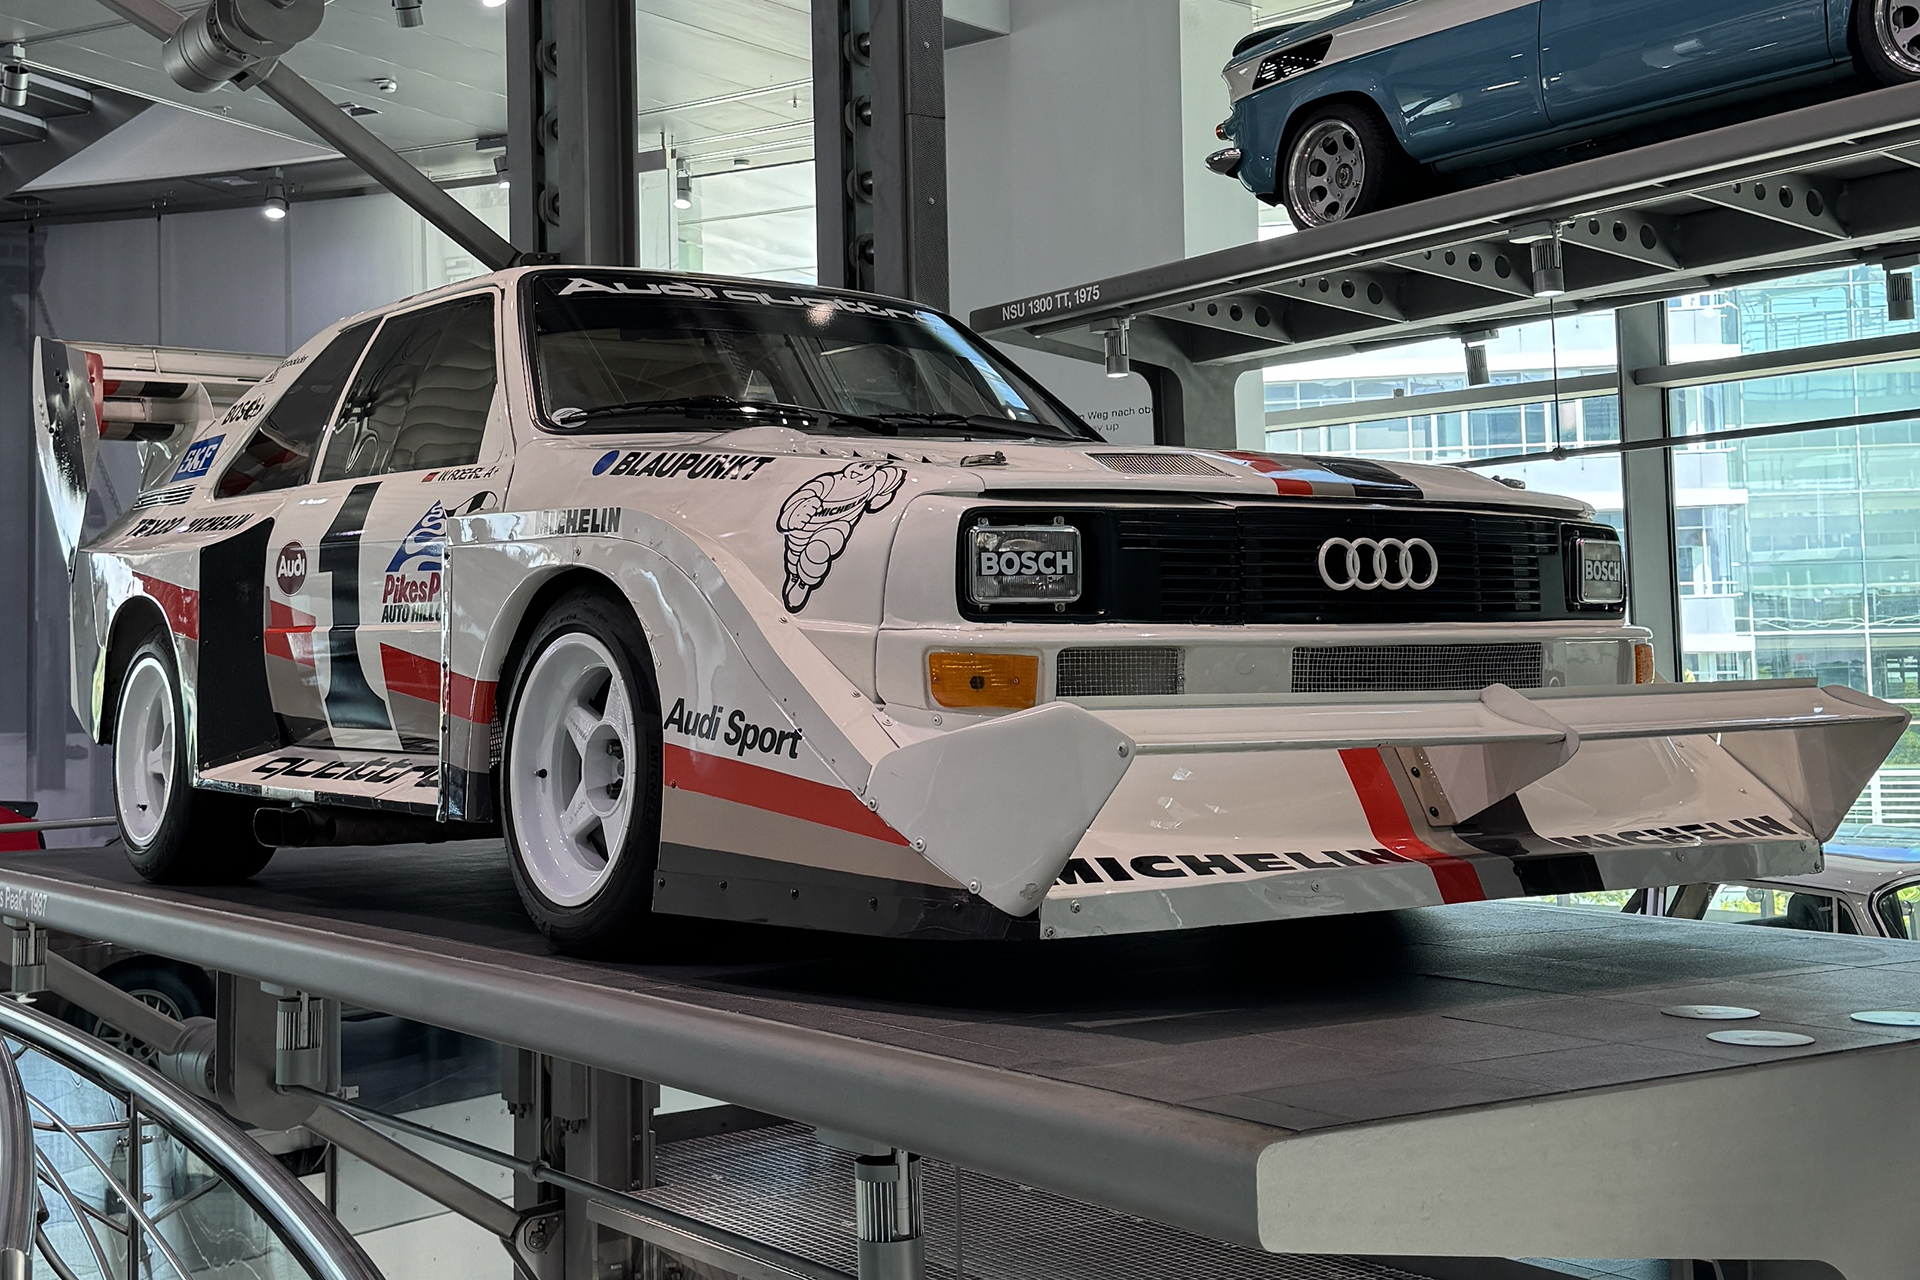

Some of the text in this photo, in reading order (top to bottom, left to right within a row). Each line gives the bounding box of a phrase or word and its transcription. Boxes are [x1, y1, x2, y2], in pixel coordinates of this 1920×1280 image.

[558, 278, 718, 299] Audi
[1002, 285, 1100, 321] NSU 1300 TT, 1975
[1087, 411, 1109, 420] Weg
[1111, 407, 1136, 417] nach
[1105, 423, 1120, 432] up
[177, 443, 218, 474] SKF
[609, 452, 777, 481] BLAUPUNKT
[184, 513, 256, 533] MICHELIN
[277, 553, 306, 578] Audi
[981, 551, 1074, 576] BOSCH
[1585, 560, 1621, 581] BOSCH
[381, 604, 410, 623] AUTO
[663, 698, 803, 759] Audi Sport
[1548, 815, 1798, 849] MICHELIN
[1053, 848, 1415, 887] MICHELIN
[30, 891, 48, 917] 1987
